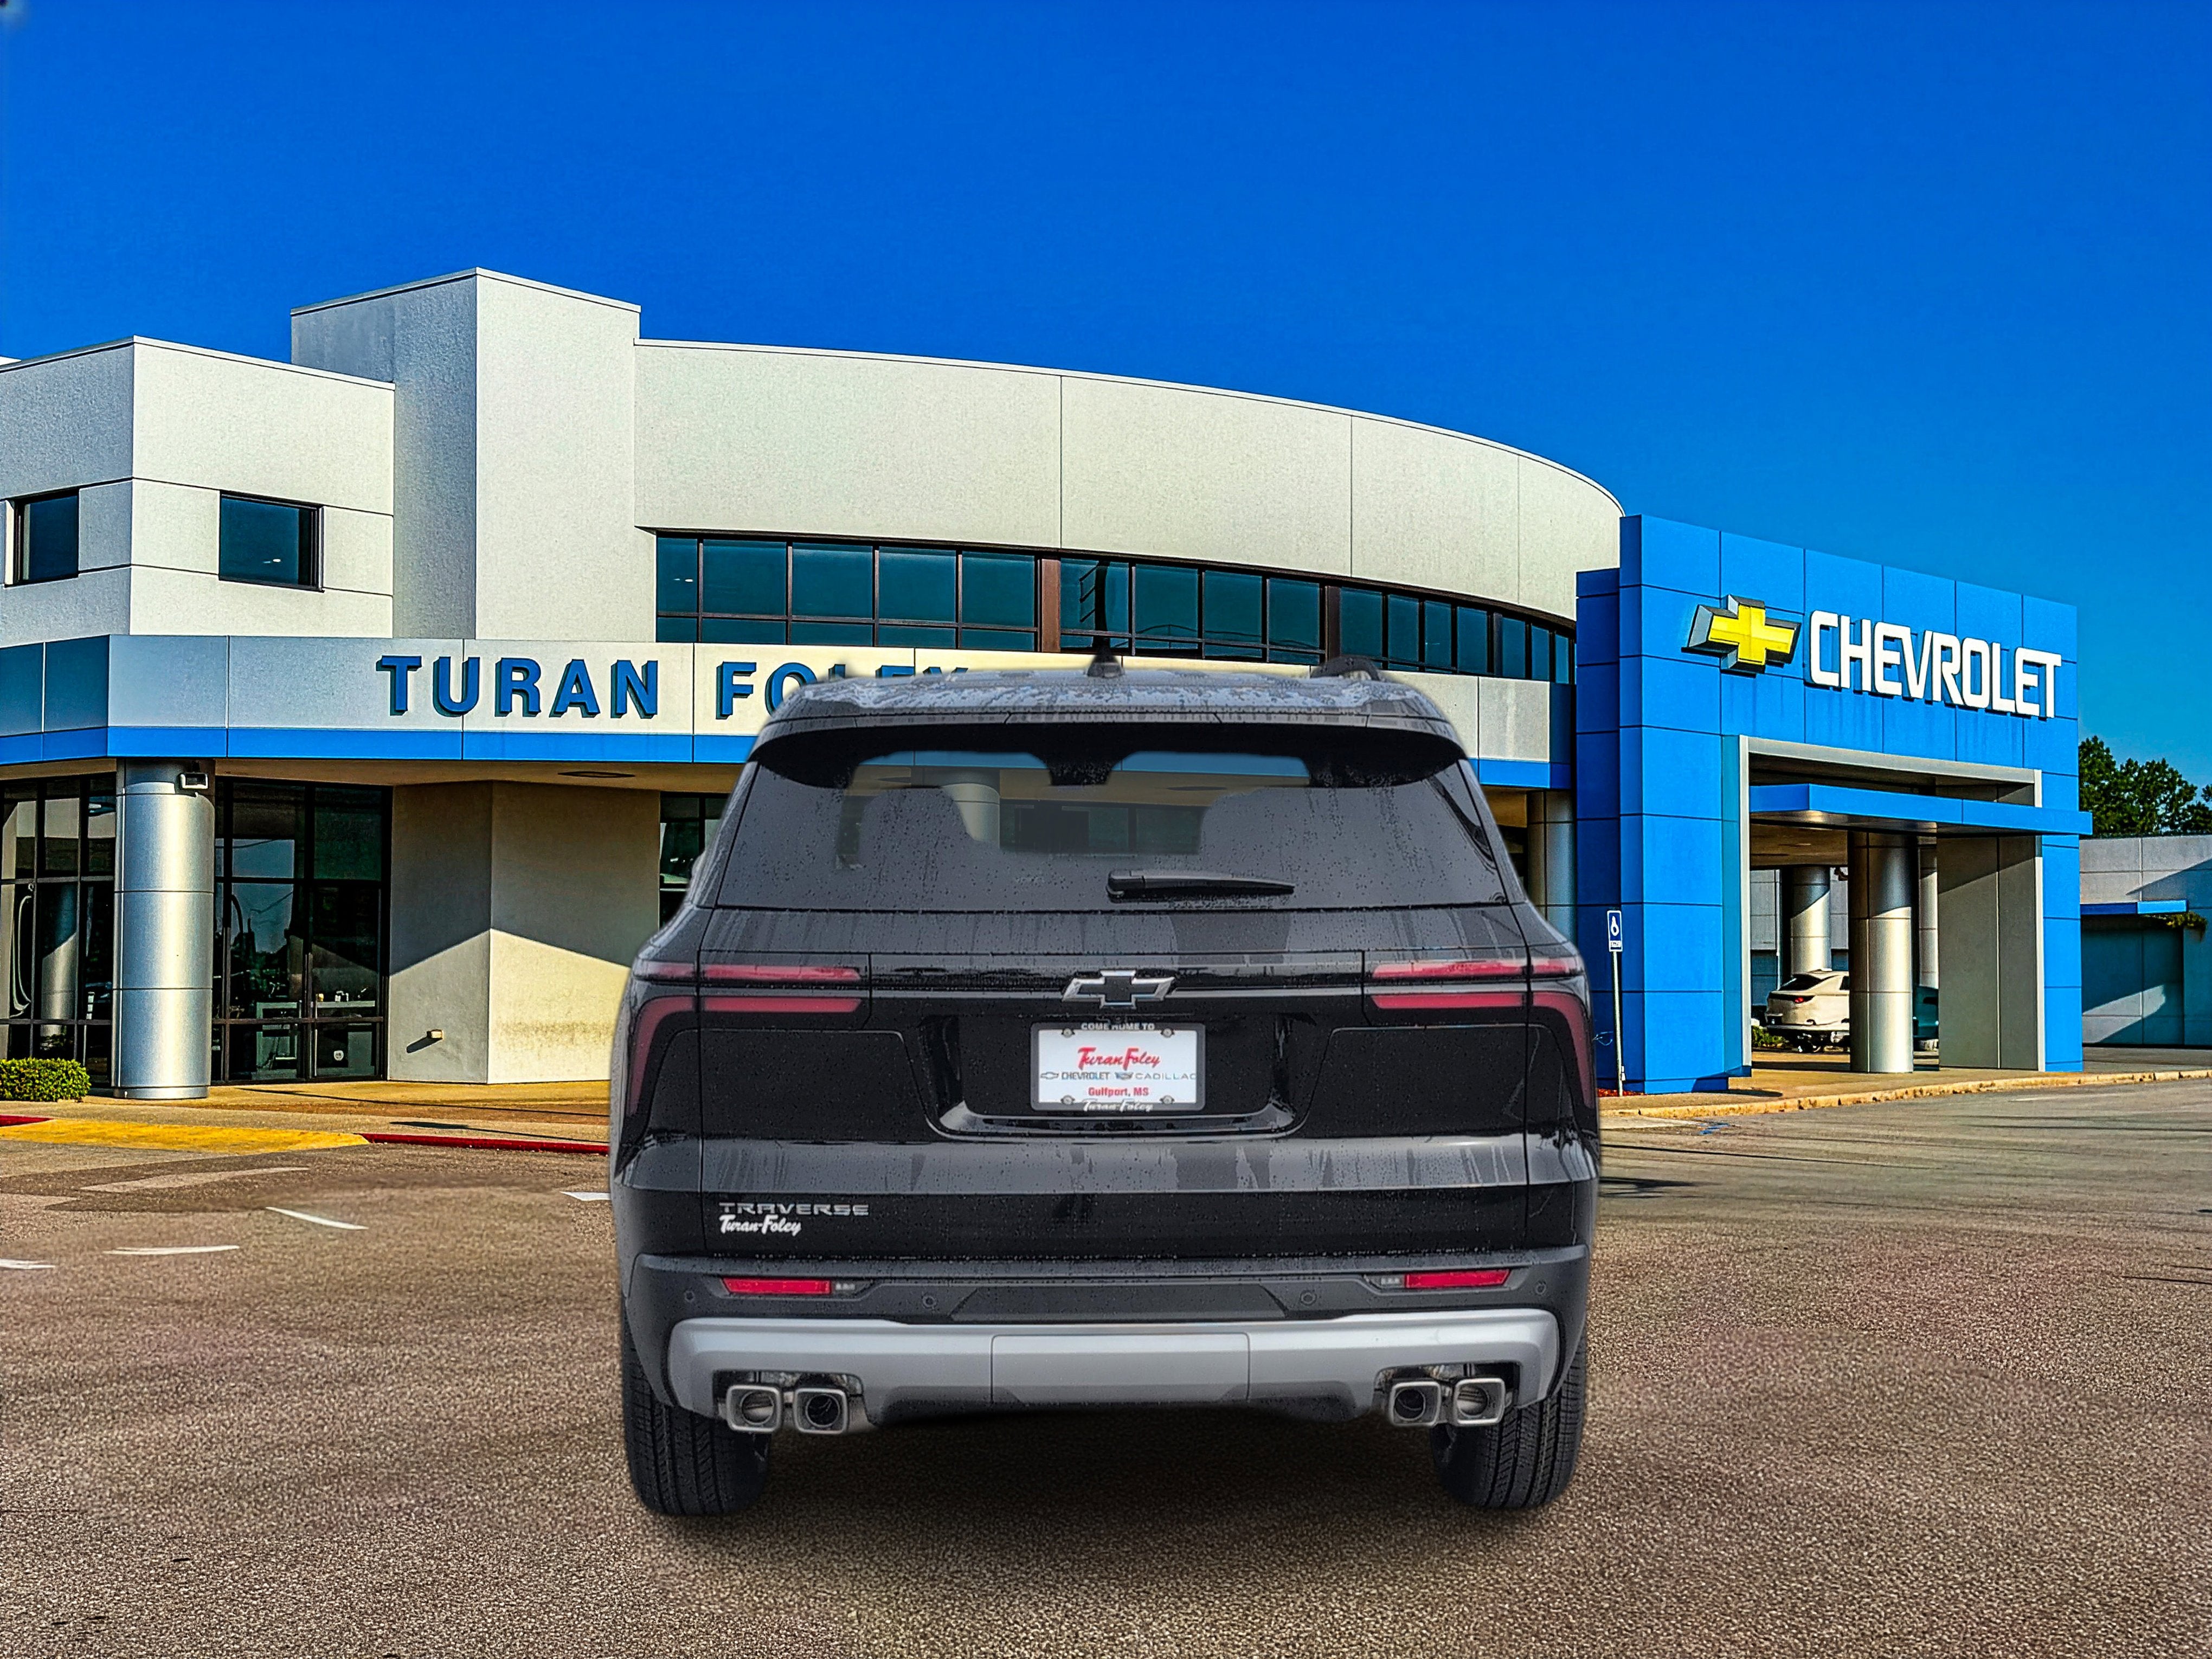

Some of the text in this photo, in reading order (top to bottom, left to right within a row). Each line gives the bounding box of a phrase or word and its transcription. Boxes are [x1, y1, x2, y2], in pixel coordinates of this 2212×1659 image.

[1810, 610, 2062, 719] CHEVROLET
[376, 655, 658, 718] TURAN
[1061, 1072, 1197, 1080] CHEVROLET CADILLAC
[1088, 1086, 1149, 1097] Gulfport, MS
[719, 1202, 869, 1216] TRAVERSE
